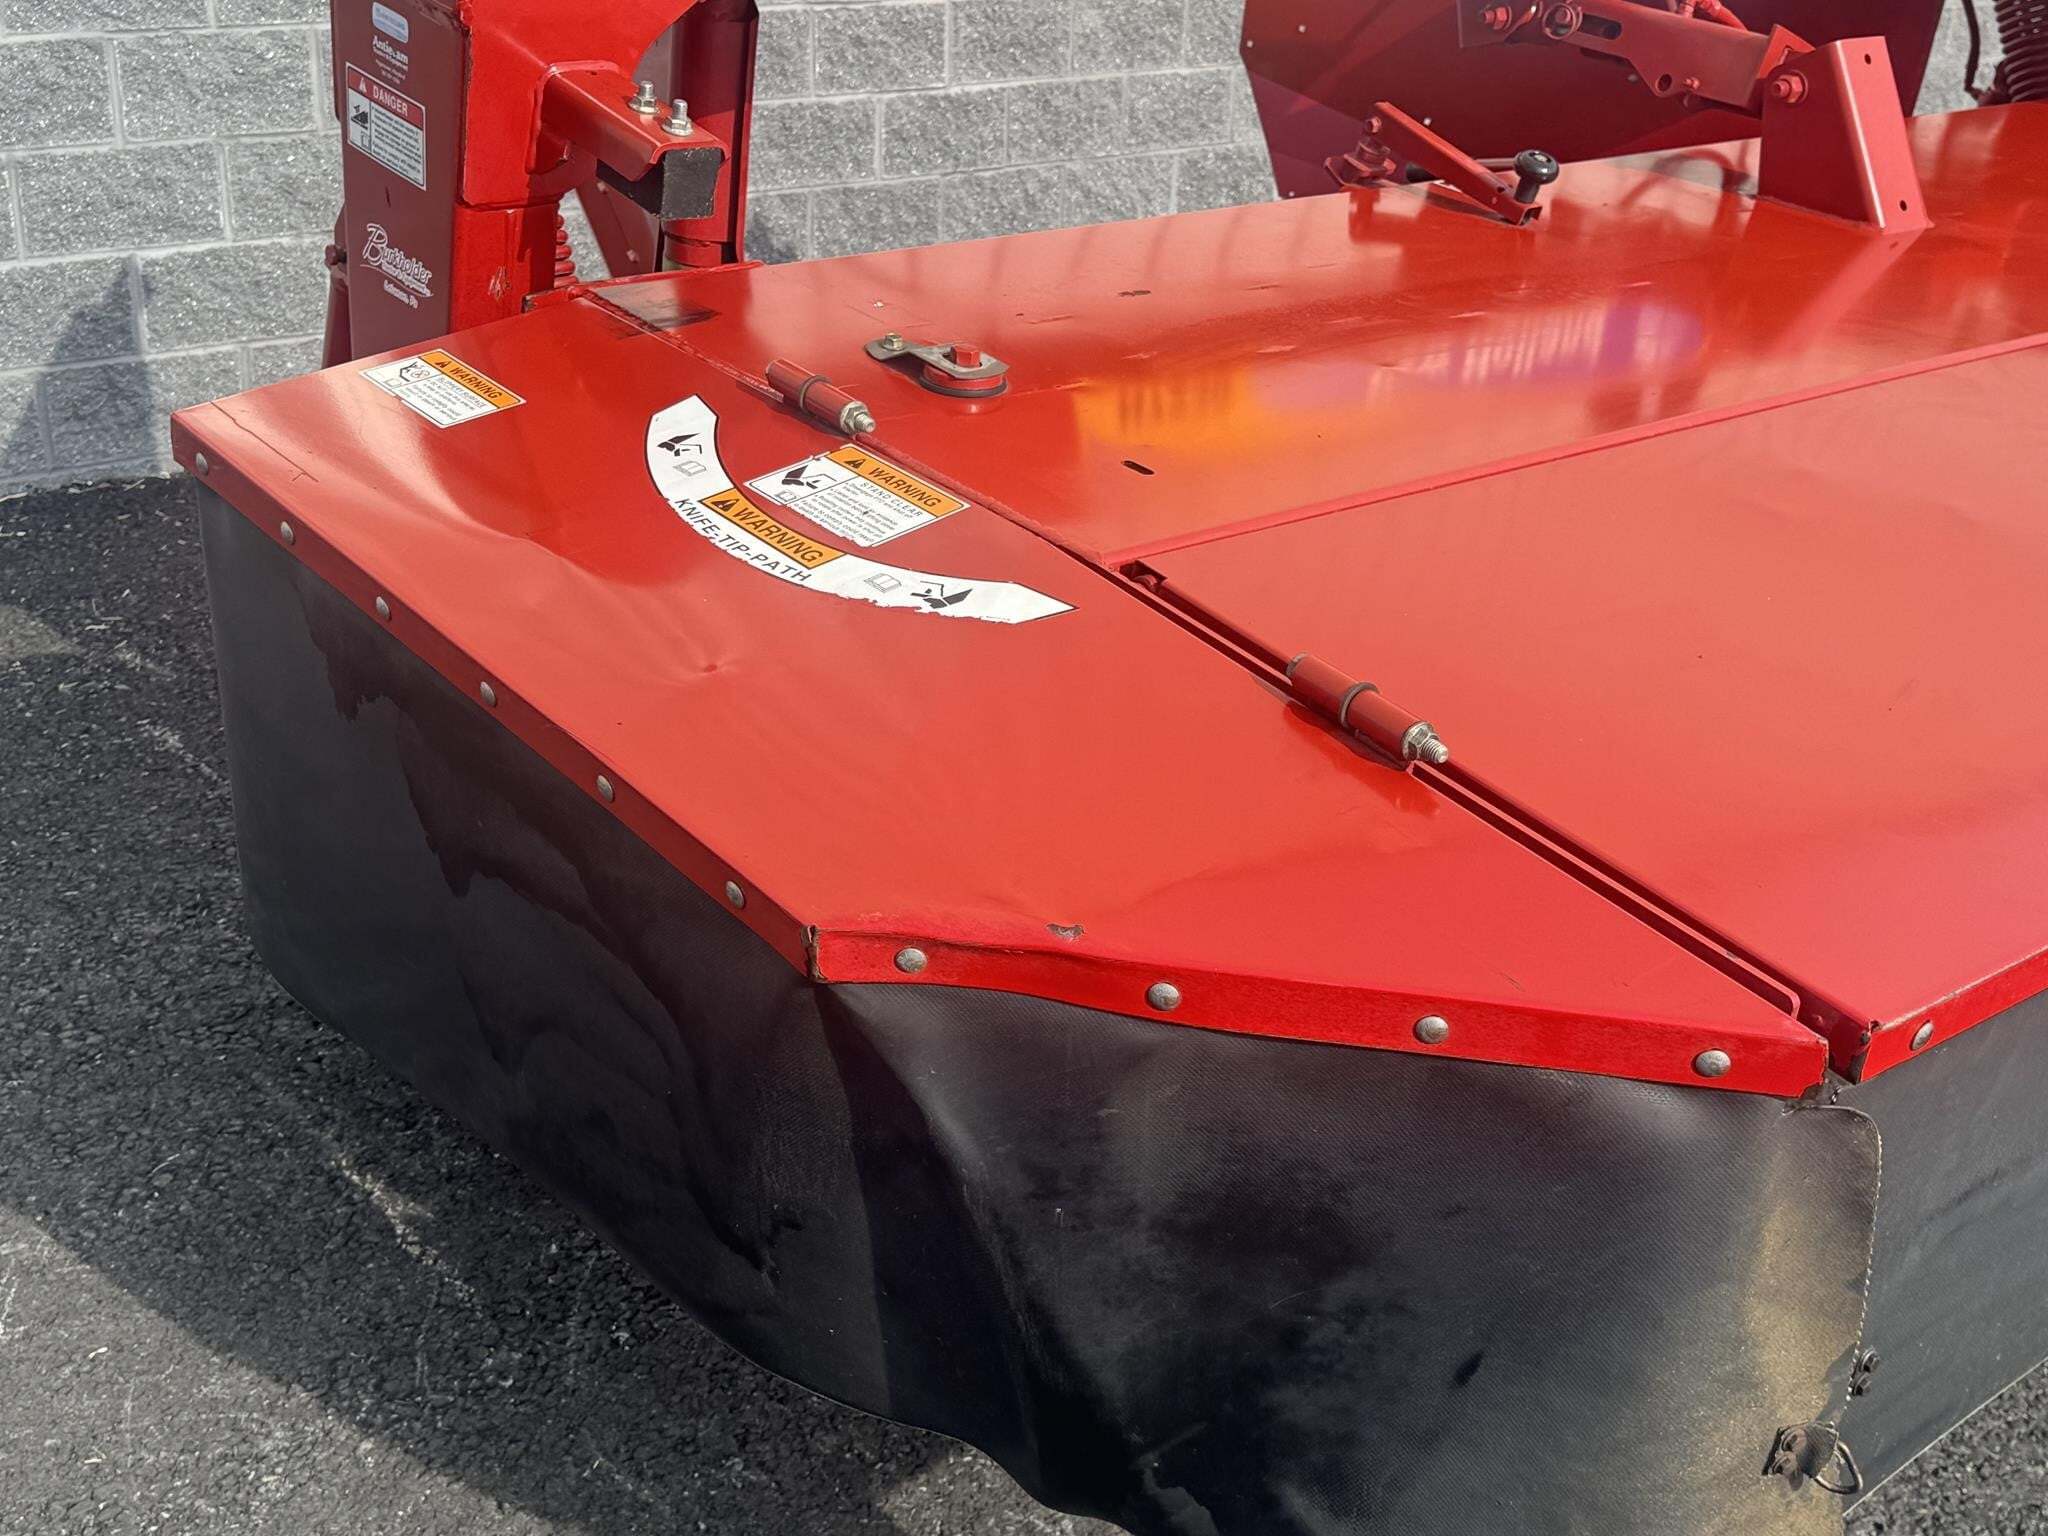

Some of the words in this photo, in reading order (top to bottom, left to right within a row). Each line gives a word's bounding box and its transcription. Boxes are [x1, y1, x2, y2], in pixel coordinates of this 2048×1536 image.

[373, 85, 408, 117] DANGER
[362, 223, 432, 286] Burkholder
[451, 367, 502, 400] WARNING
[861, 482, 891, 499] STAND
[891, 499, 923, 517] CLEAR
[868, 467, 941, 508] WARNING
[674, 498, 813, 582] KNIFE-TIP-PATH
[733, 508, 824, 563] WARNING
